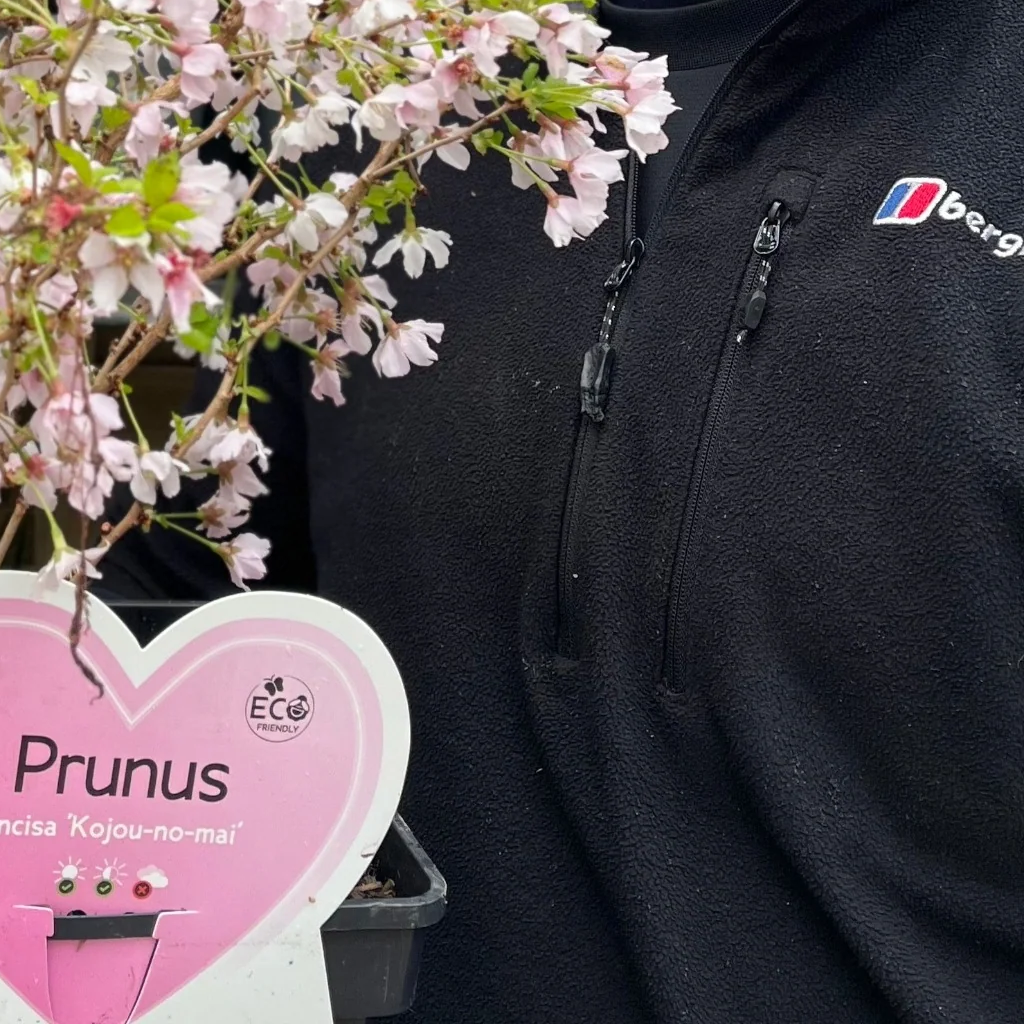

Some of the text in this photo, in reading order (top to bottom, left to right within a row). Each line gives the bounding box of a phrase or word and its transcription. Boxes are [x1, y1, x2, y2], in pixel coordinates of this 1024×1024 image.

[937, 191, 1024, 258] berg
[256, 723, 300, 733] FRIENDLY
[14, 734, 231, 803] Prunus
